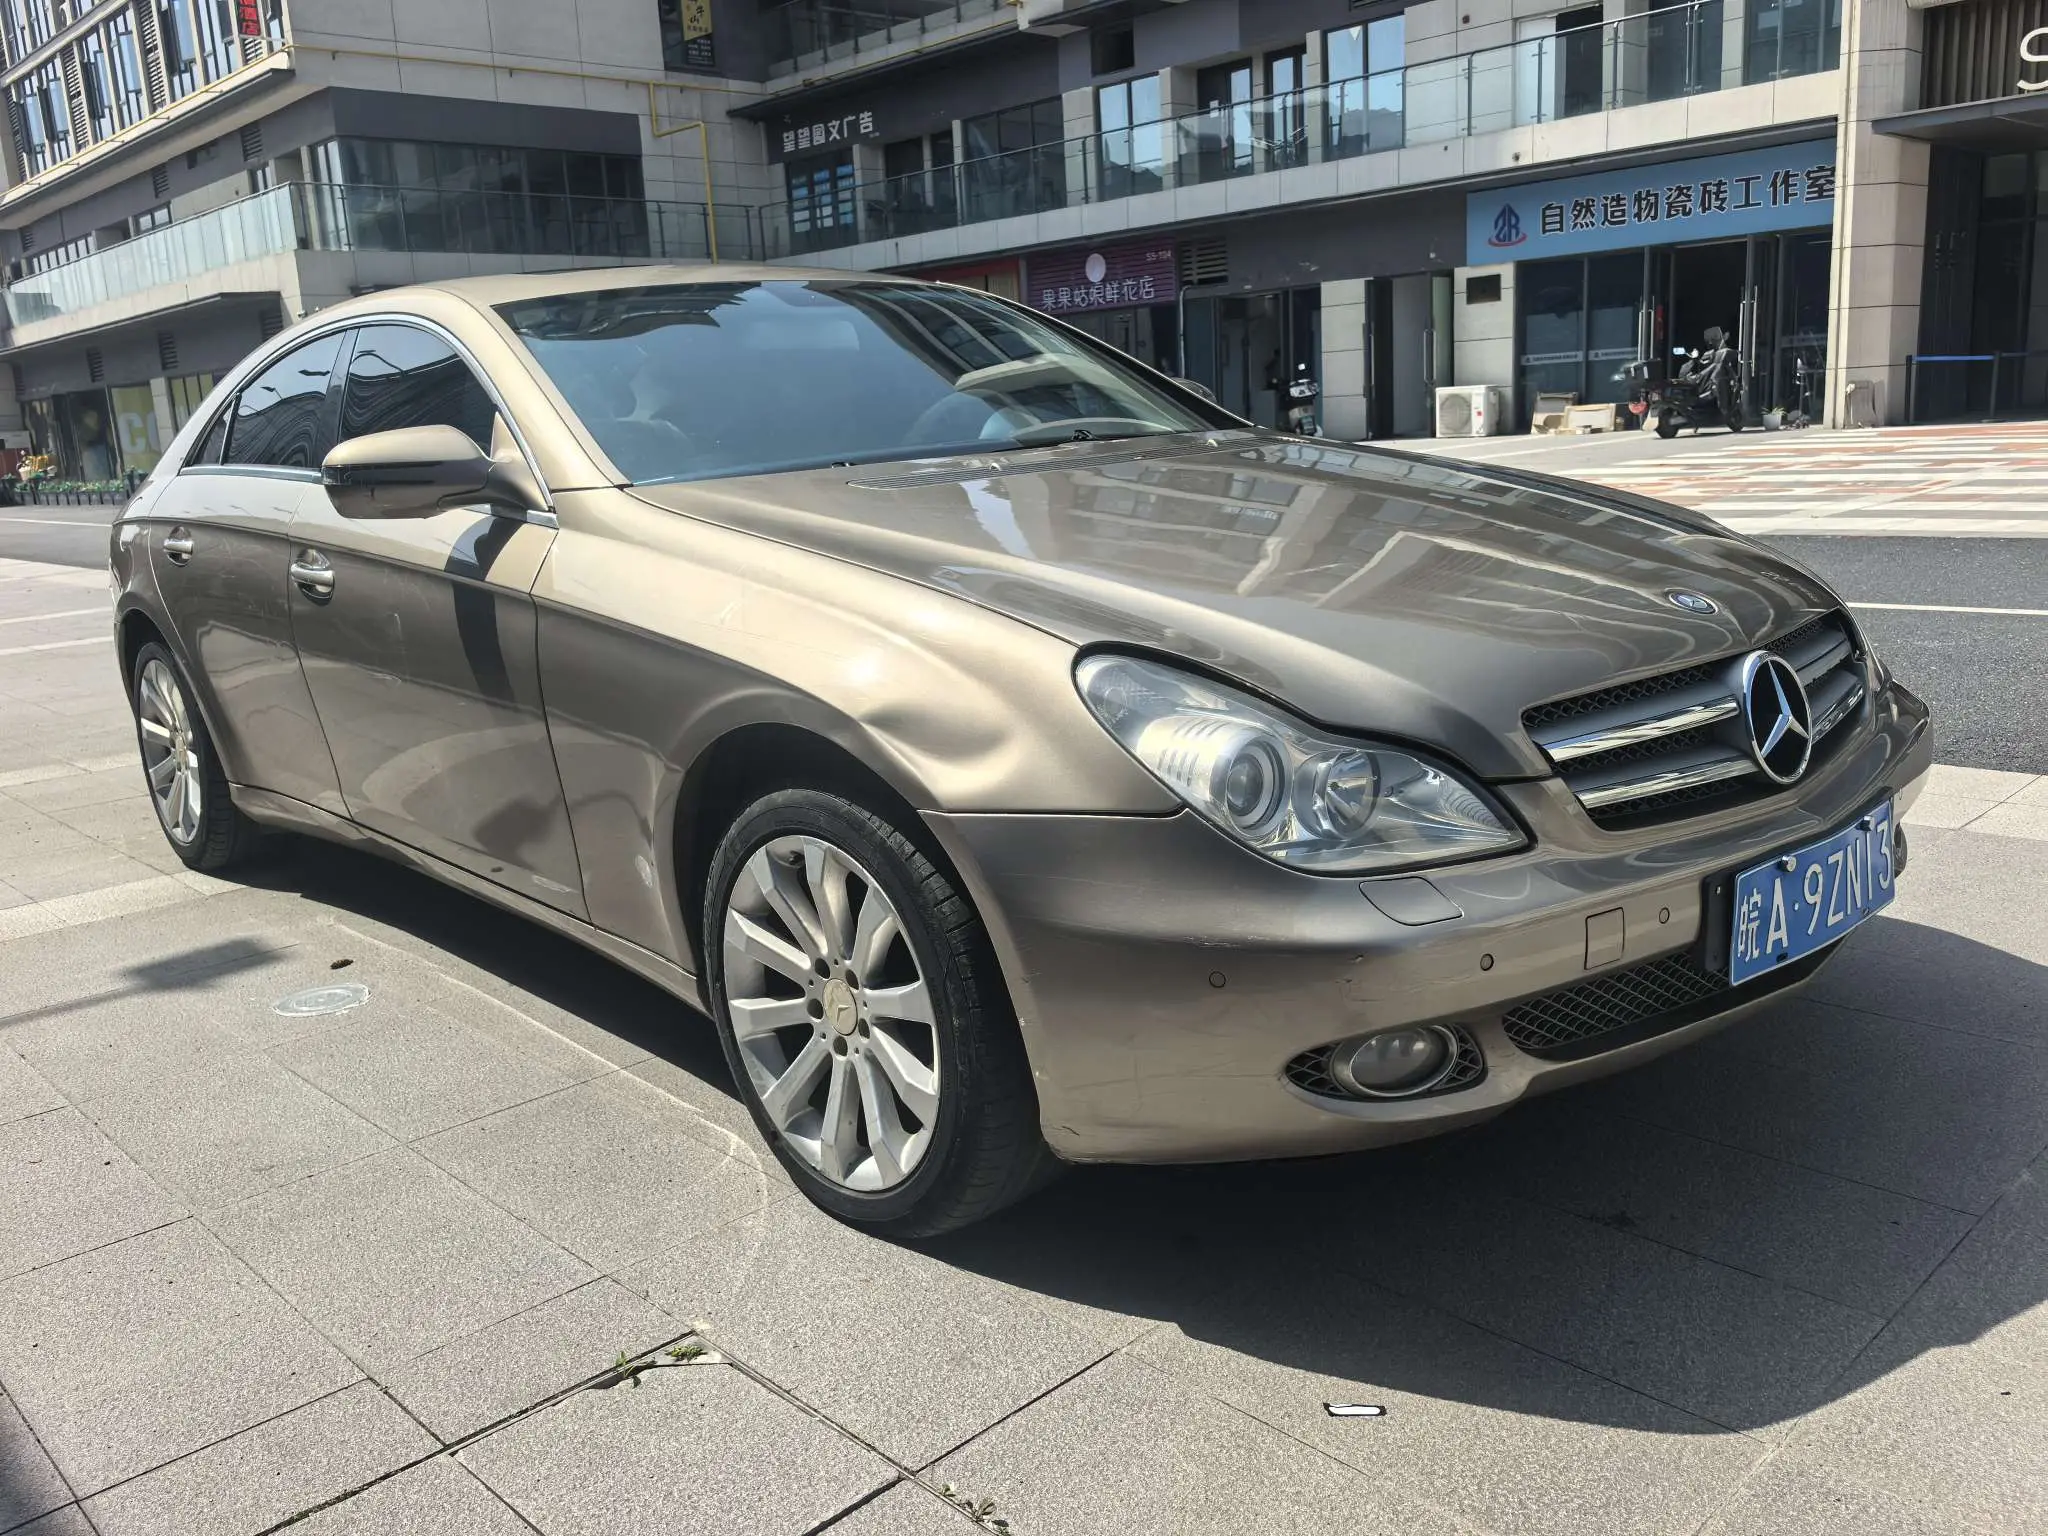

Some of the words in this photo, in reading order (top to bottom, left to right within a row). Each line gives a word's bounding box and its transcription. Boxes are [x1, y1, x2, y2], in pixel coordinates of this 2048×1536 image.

[782, 111, 873, 152] 望望图文广告
[1539, 164, 1836, 236] 自然造物瓷砖工作室
[1042, 275, 1155, 312] 果果姑娘鲜花店
